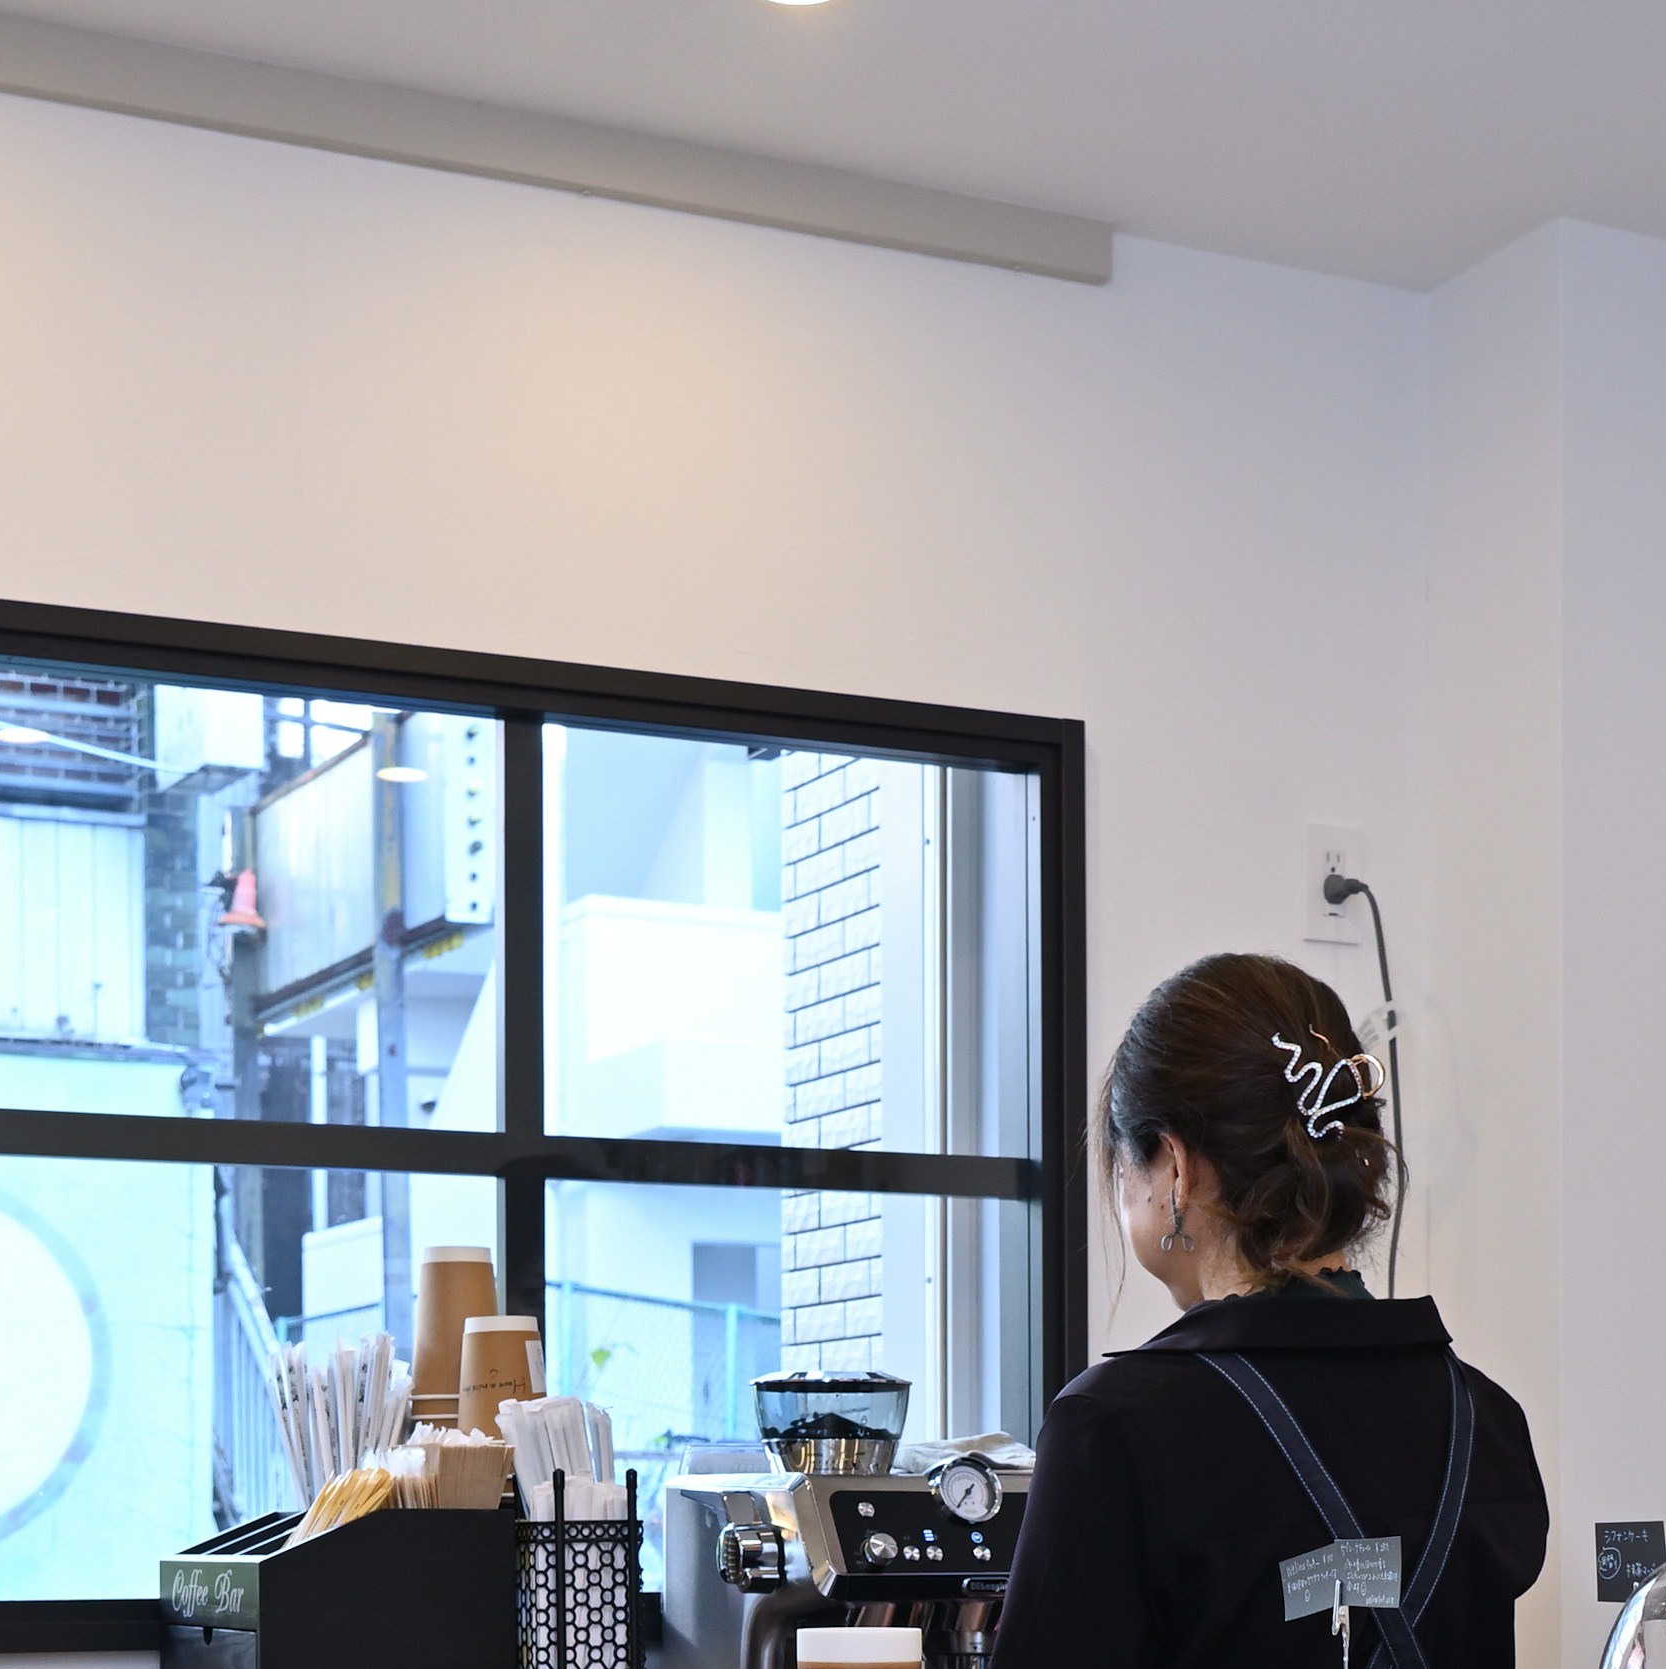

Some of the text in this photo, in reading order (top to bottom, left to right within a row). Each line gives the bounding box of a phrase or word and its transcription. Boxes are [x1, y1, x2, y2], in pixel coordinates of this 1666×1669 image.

[1604, 1528, 1649, 1544] シフォンケーキ
[172, 1569, 244, 1618] Coffee Bar
